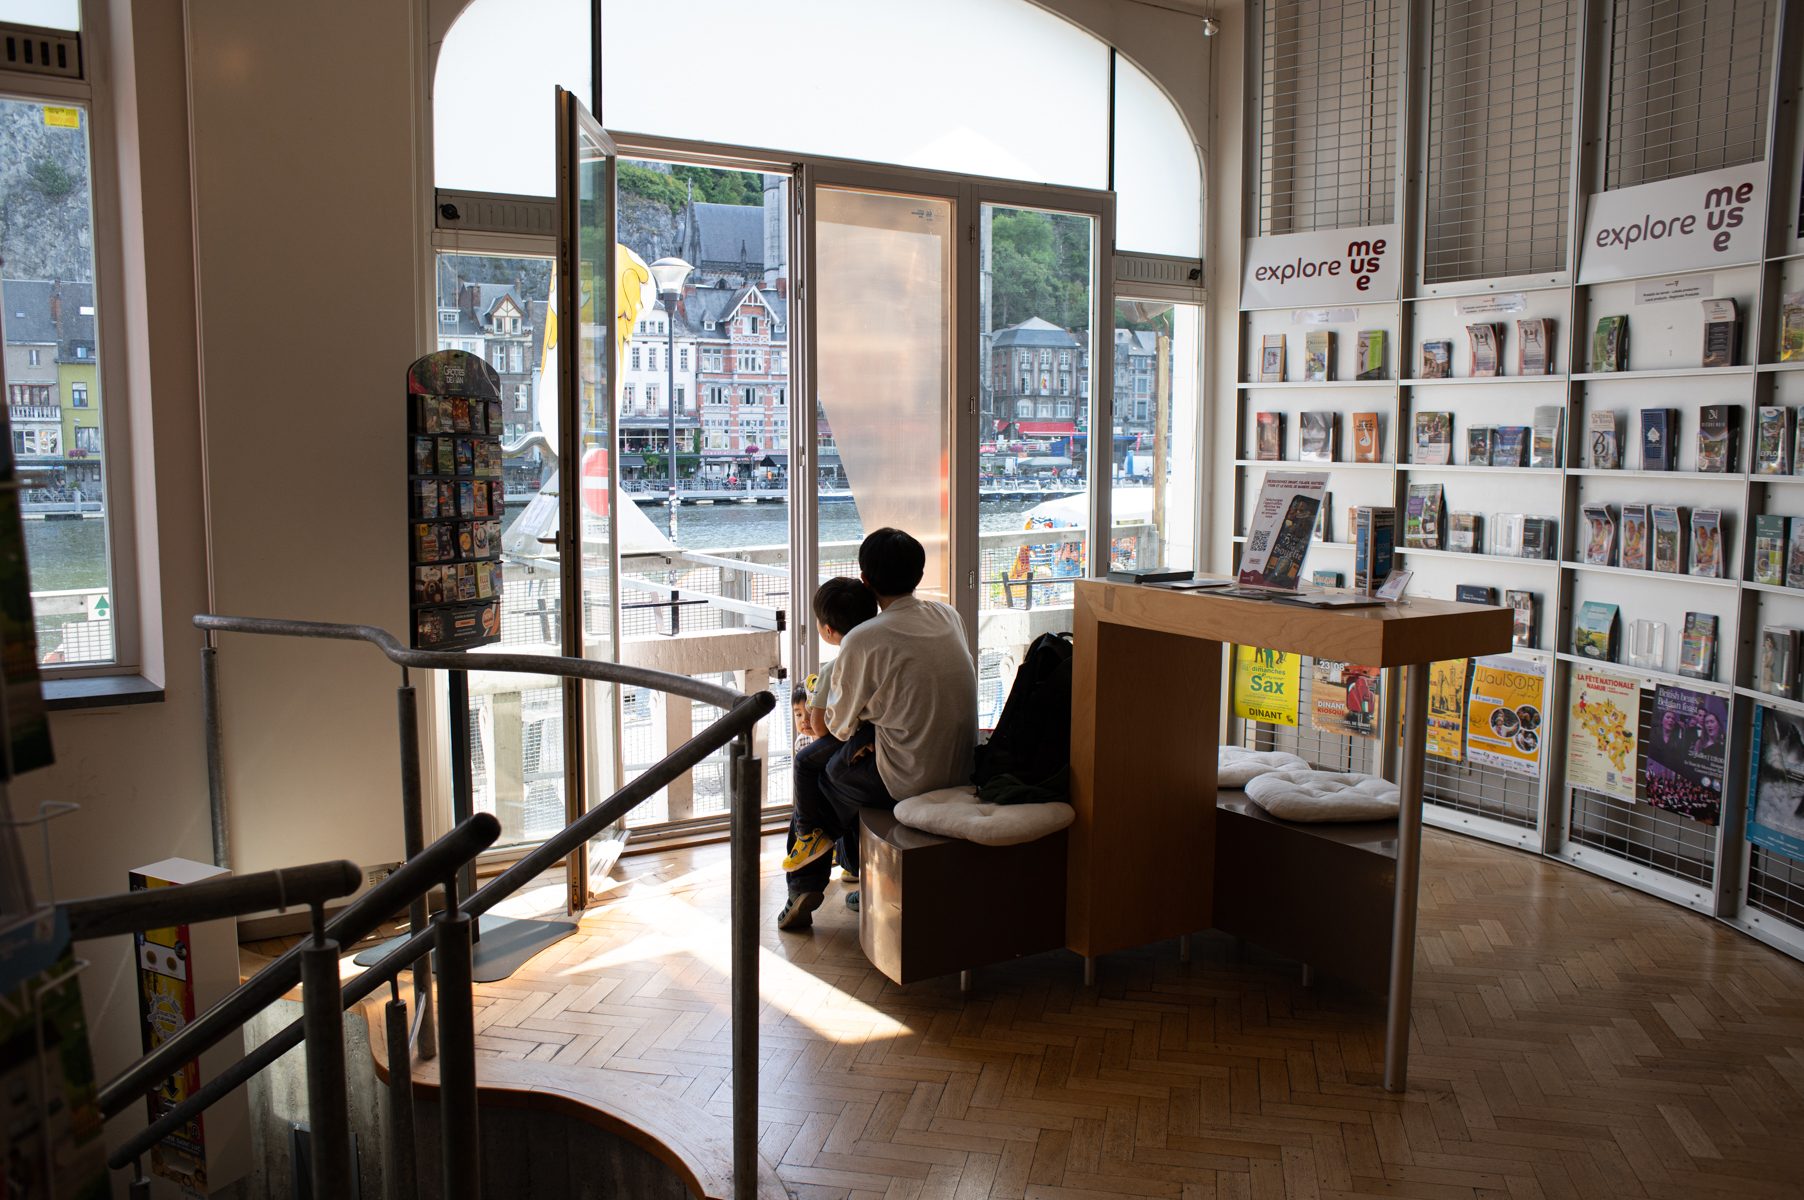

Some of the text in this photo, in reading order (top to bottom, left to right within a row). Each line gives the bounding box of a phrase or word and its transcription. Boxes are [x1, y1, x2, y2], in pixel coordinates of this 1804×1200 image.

[1596, 214, 1696, 250] explore
[1256, 258, 1341, 284] explore
[1252, 666, 1286, 675] dimanches
[1250, 675, 1284, 694] Sax
[1586, 683, 1606, 691] NAMUR
[1600, 678, 1635, 690] NATIONALE
[1659, 688, 1679, 700] British
[1318, 700, 1345, 709] DINANT
[1658, 696, 1681, 710] Belgian
[1248, 708, 1282, 720] DINANT
